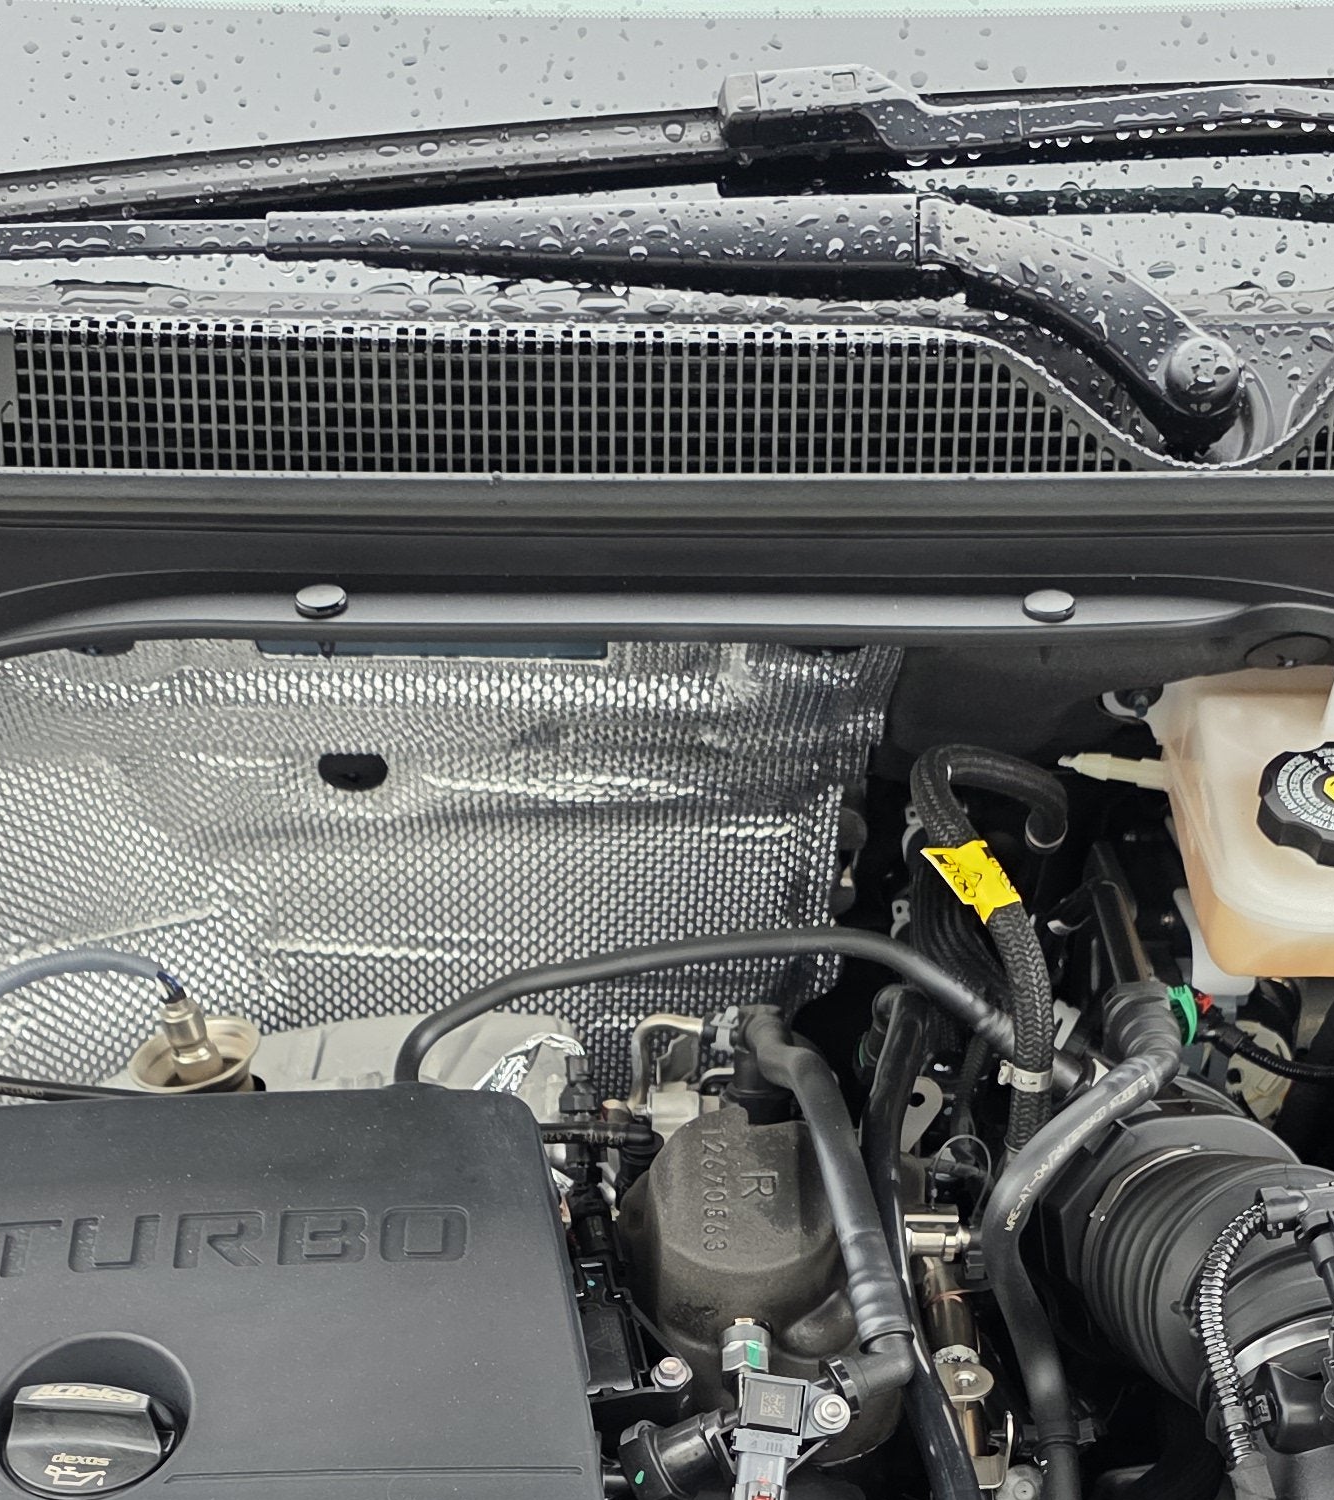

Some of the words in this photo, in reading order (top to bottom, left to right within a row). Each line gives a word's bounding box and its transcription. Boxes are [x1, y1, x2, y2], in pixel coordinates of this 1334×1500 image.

[740, 1168, 779, 1200] R
[29, 1385, 138, 1403] ACDelco
[51, 1452, 112, 1466] dexos
